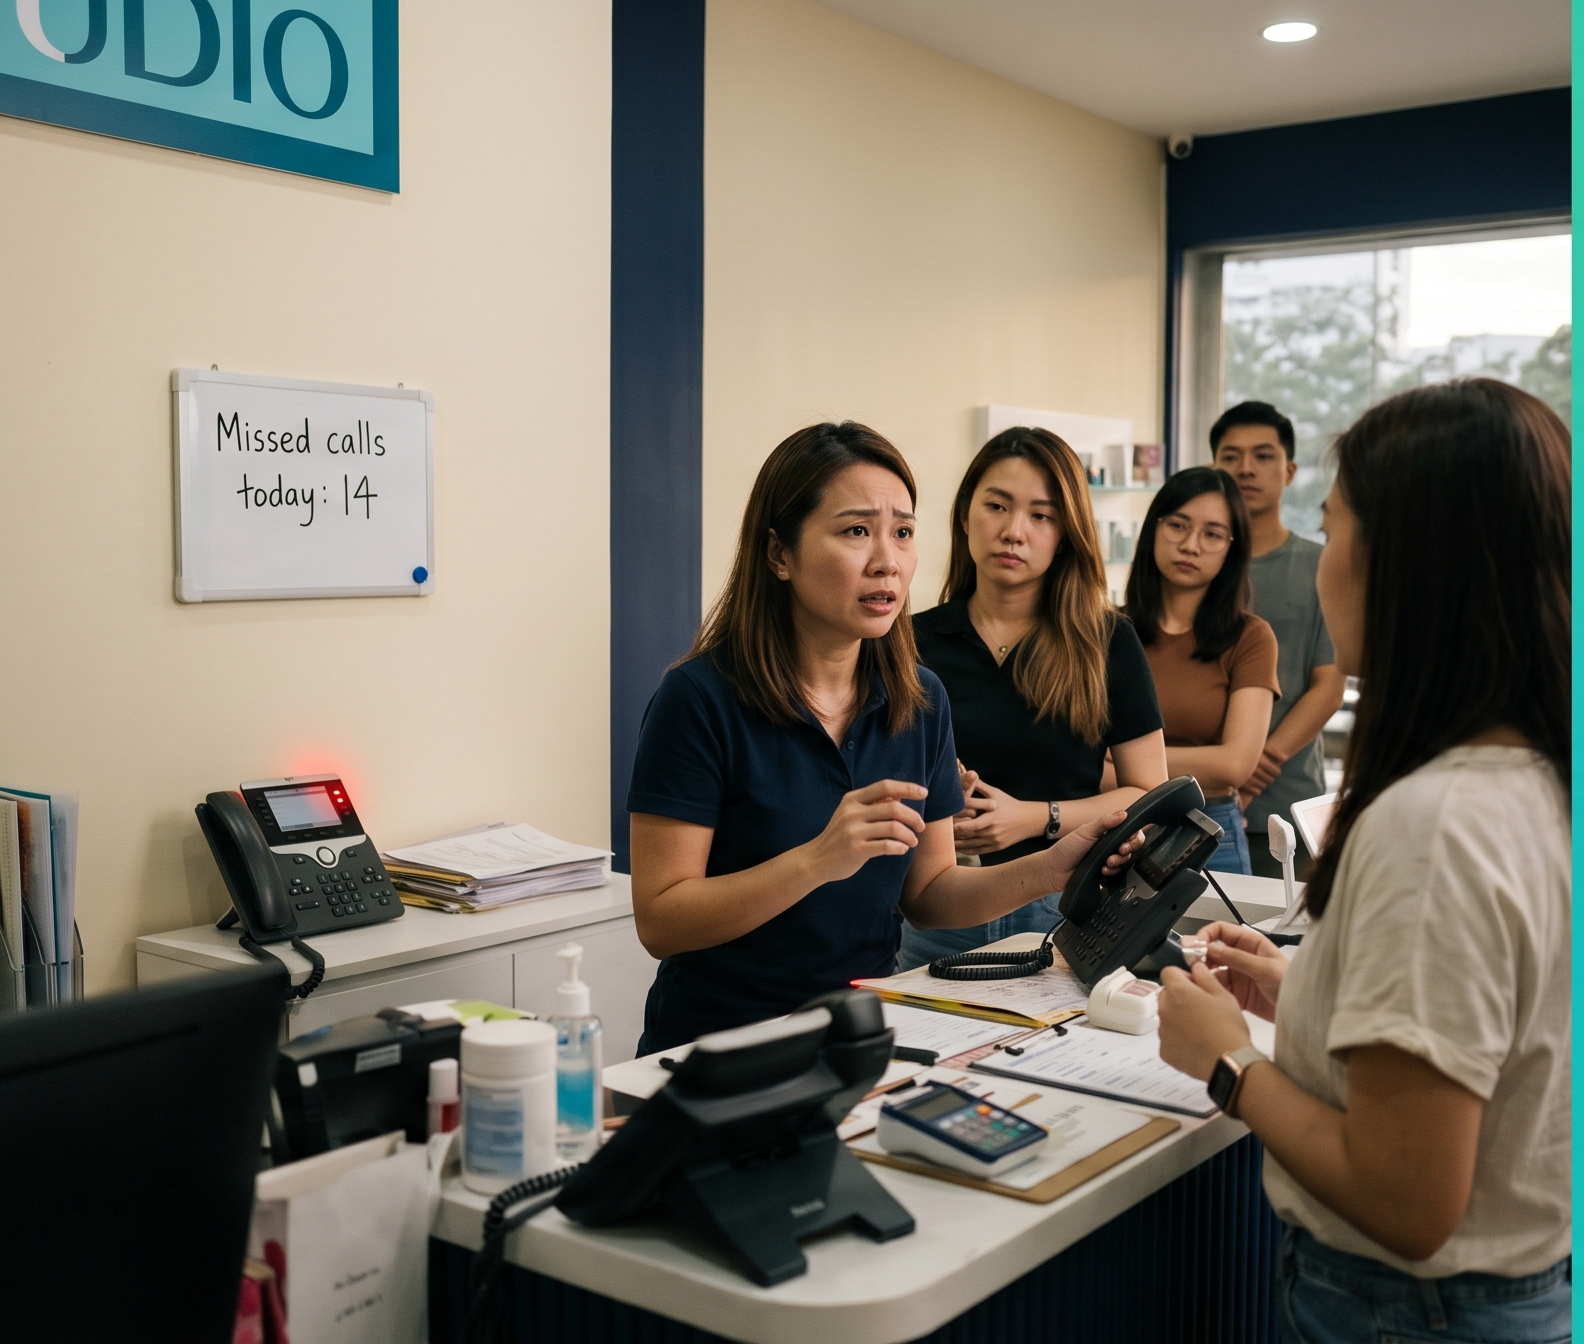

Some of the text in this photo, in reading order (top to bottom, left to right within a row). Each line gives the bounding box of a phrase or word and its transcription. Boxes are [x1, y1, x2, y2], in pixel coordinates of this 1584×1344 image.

[217, 411, 386, 457] Missed calls
[236, 473, 379, 528] today: 14
